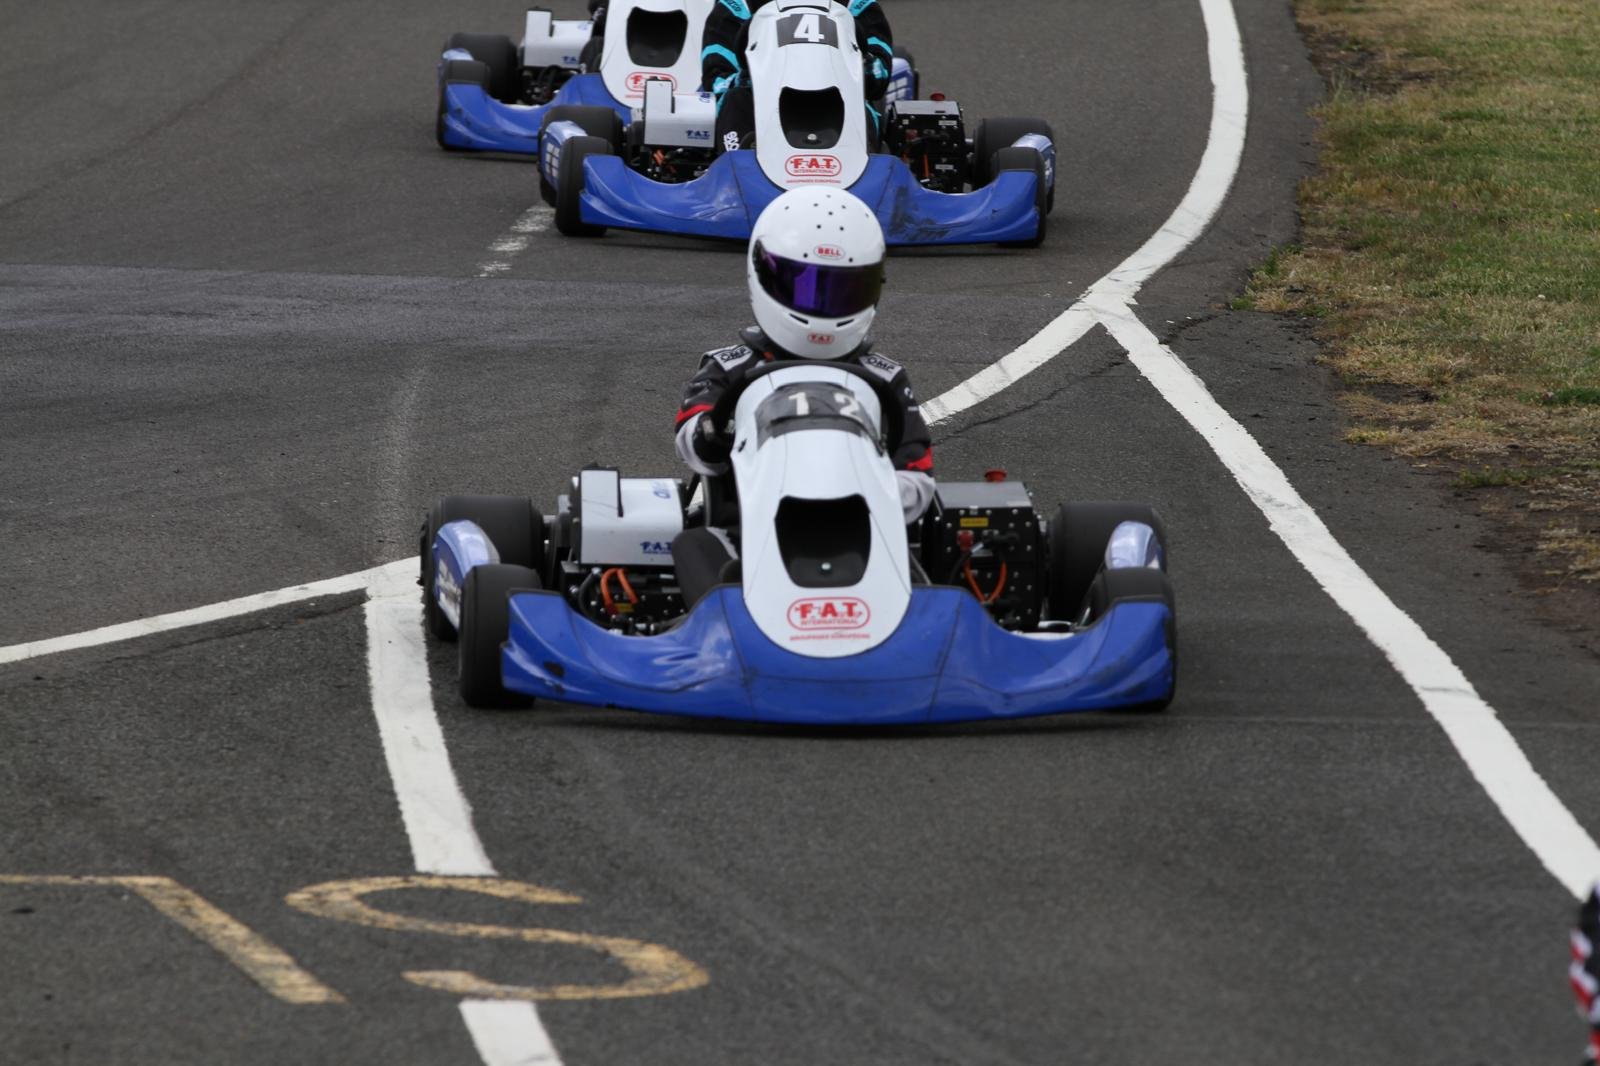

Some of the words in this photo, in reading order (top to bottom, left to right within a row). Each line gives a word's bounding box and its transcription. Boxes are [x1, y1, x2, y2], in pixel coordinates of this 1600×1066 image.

[793, 13, 825, 42] 4
[817, 247, 841, 257] BELL
[867, 356, 895, 372] OMP
